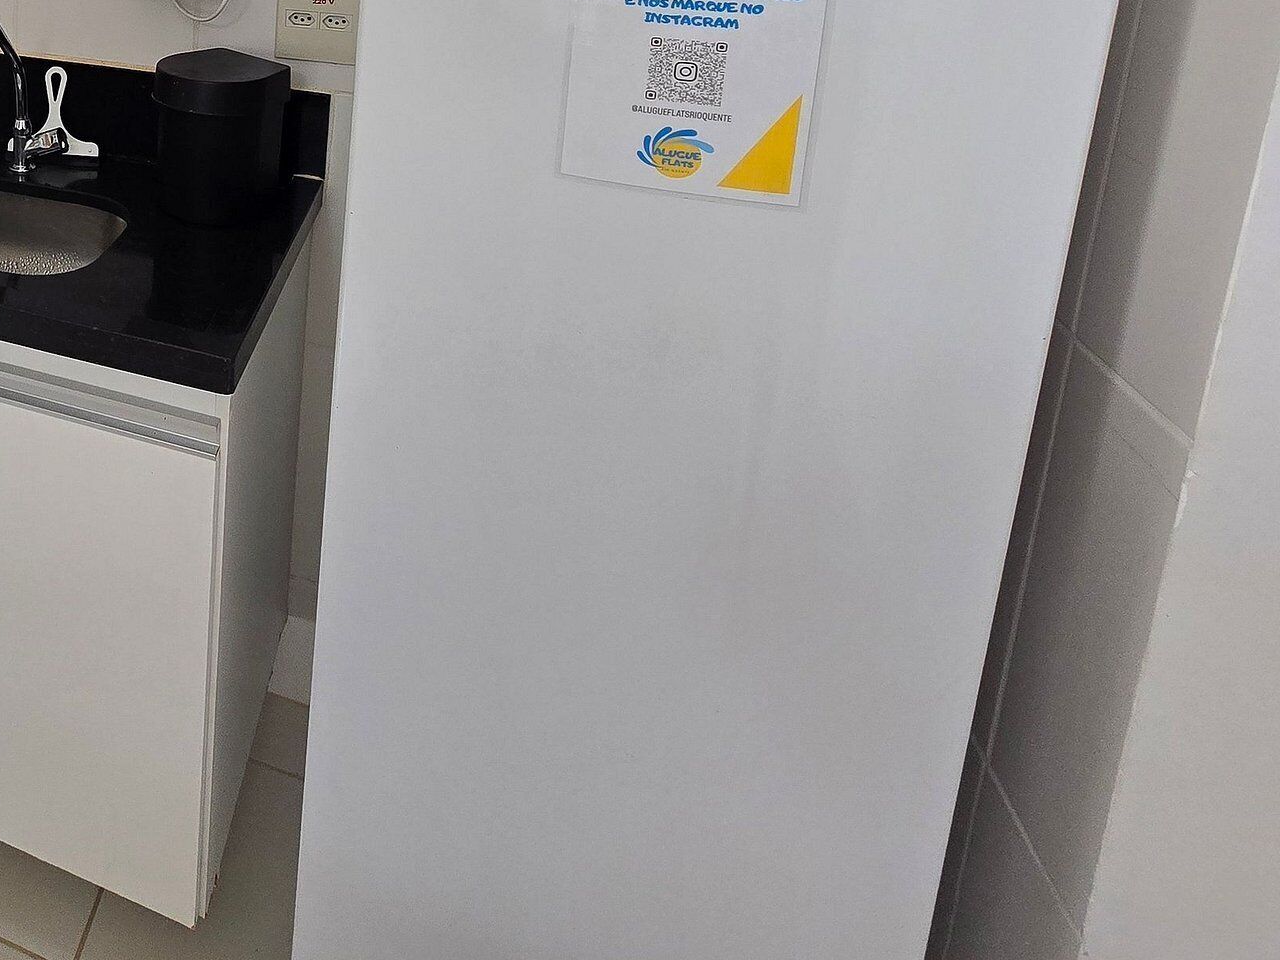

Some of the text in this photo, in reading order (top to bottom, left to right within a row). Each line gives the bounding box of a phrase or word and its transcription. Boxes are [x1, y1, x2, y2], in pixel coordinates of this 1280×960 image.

[740, 2, 765, 15] NO
[644, 11, 739, 29] INSTAGRAM
[631, 104, 732, 123] @ALUGUEFLATSRIOQUENTE
[653, 147, 702, 160] ALUGUE
[661, 157, 694, 168] FLATS
